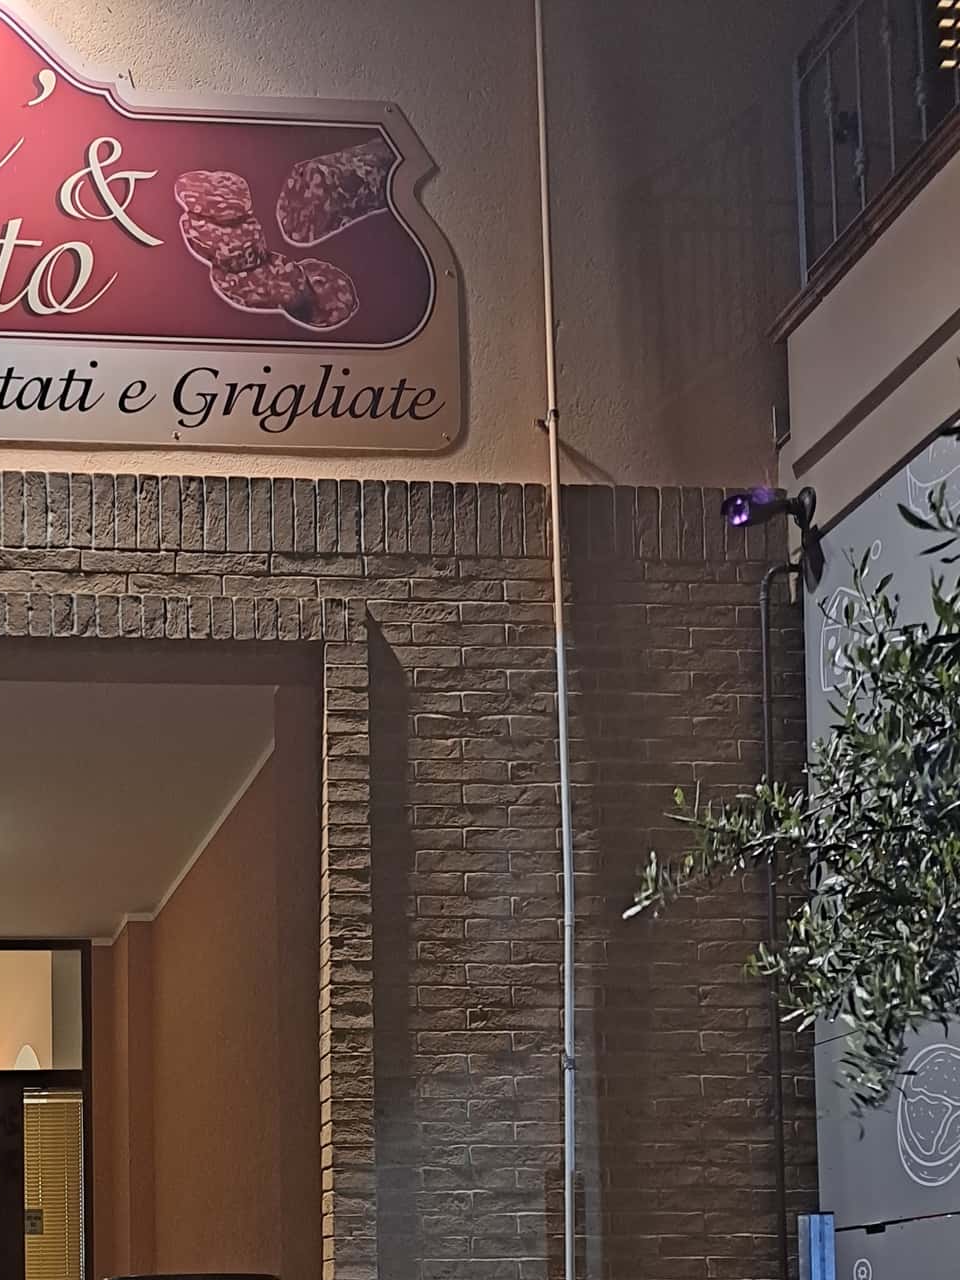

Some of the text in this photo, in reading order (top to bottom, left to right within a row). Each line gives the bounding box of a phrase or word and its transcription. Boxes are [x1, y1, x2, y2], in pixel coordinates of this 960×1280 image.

[59, 137, 164, 246] &
[118, 378, 157, 413] e
[172, 364, 446, 432] Grigliate
